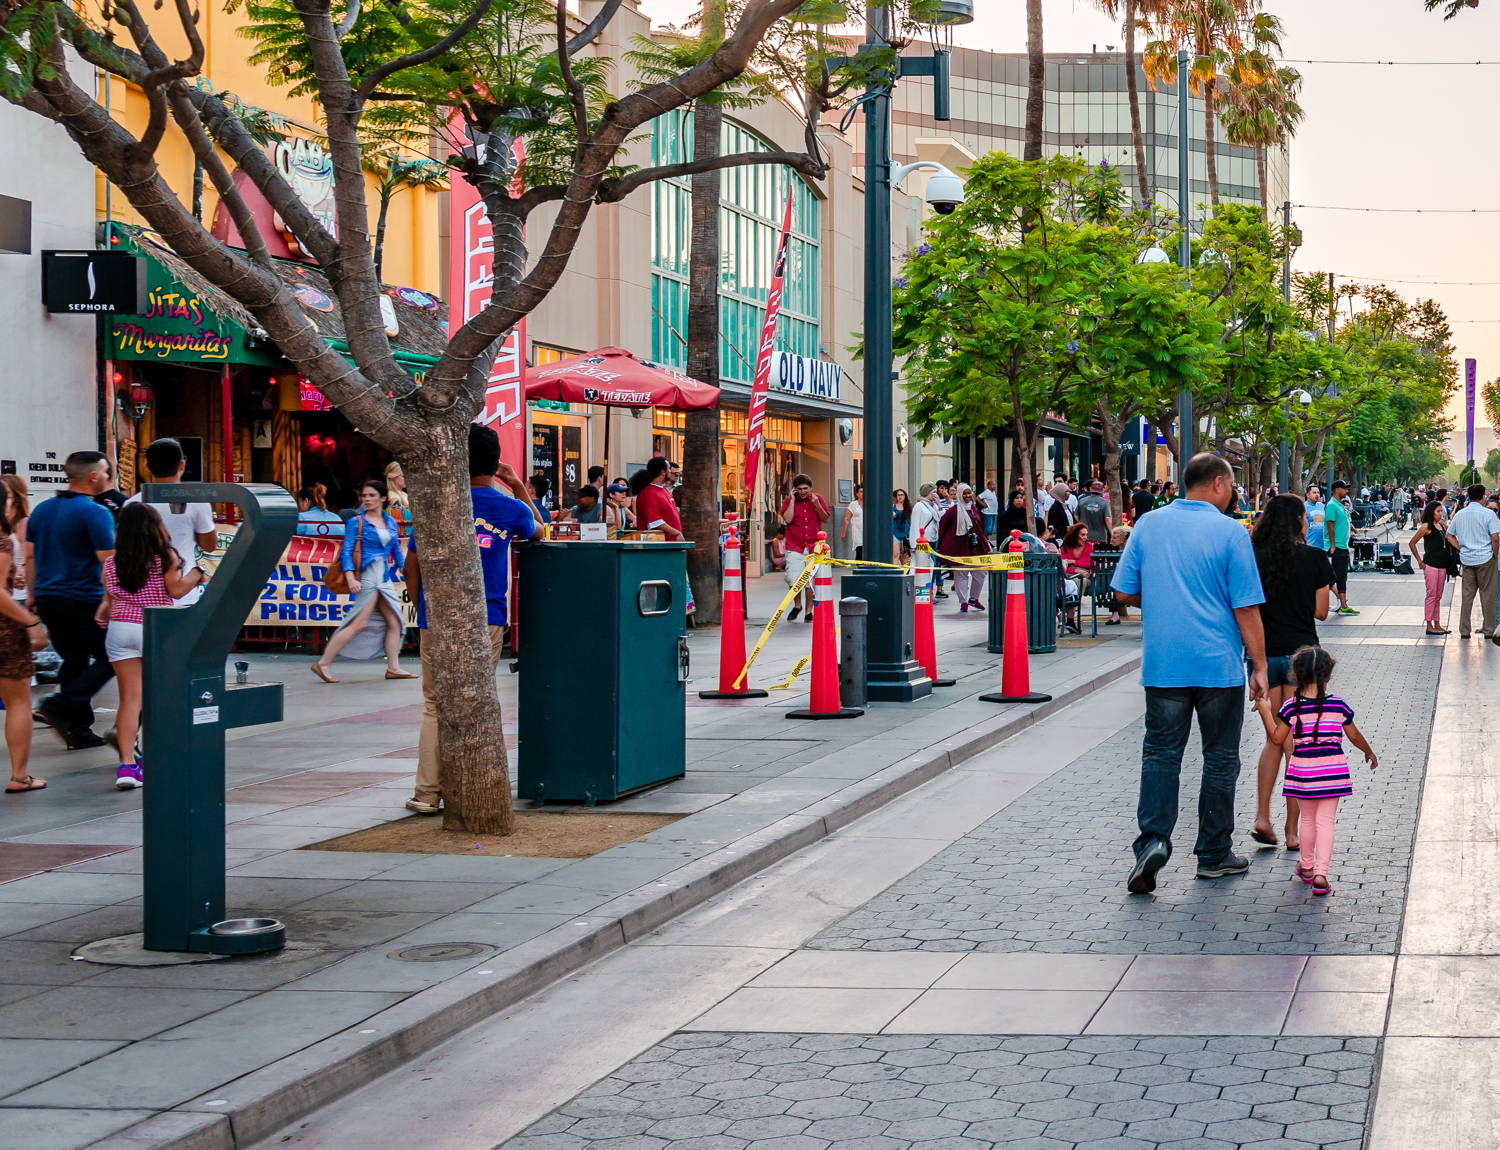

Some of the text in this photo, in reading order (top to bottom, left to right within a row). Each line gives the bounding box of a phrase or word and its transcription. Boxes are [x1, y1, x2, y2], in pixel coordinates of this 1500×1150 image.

[68, 303, 115, 311] SEPHORA
[145, 286, 204, 326] JITAS
[113, 323, 232, 359] Margaritas
[779, 352, 841, 399] OLD NAVY
[601, 390, 652, 404] TECATE
[257, 424, 267, 439] A
[260, 583, 278, 600] 2
[285, 583, 337, 602] FOR
[260, 602, 354, 622] PRICES
